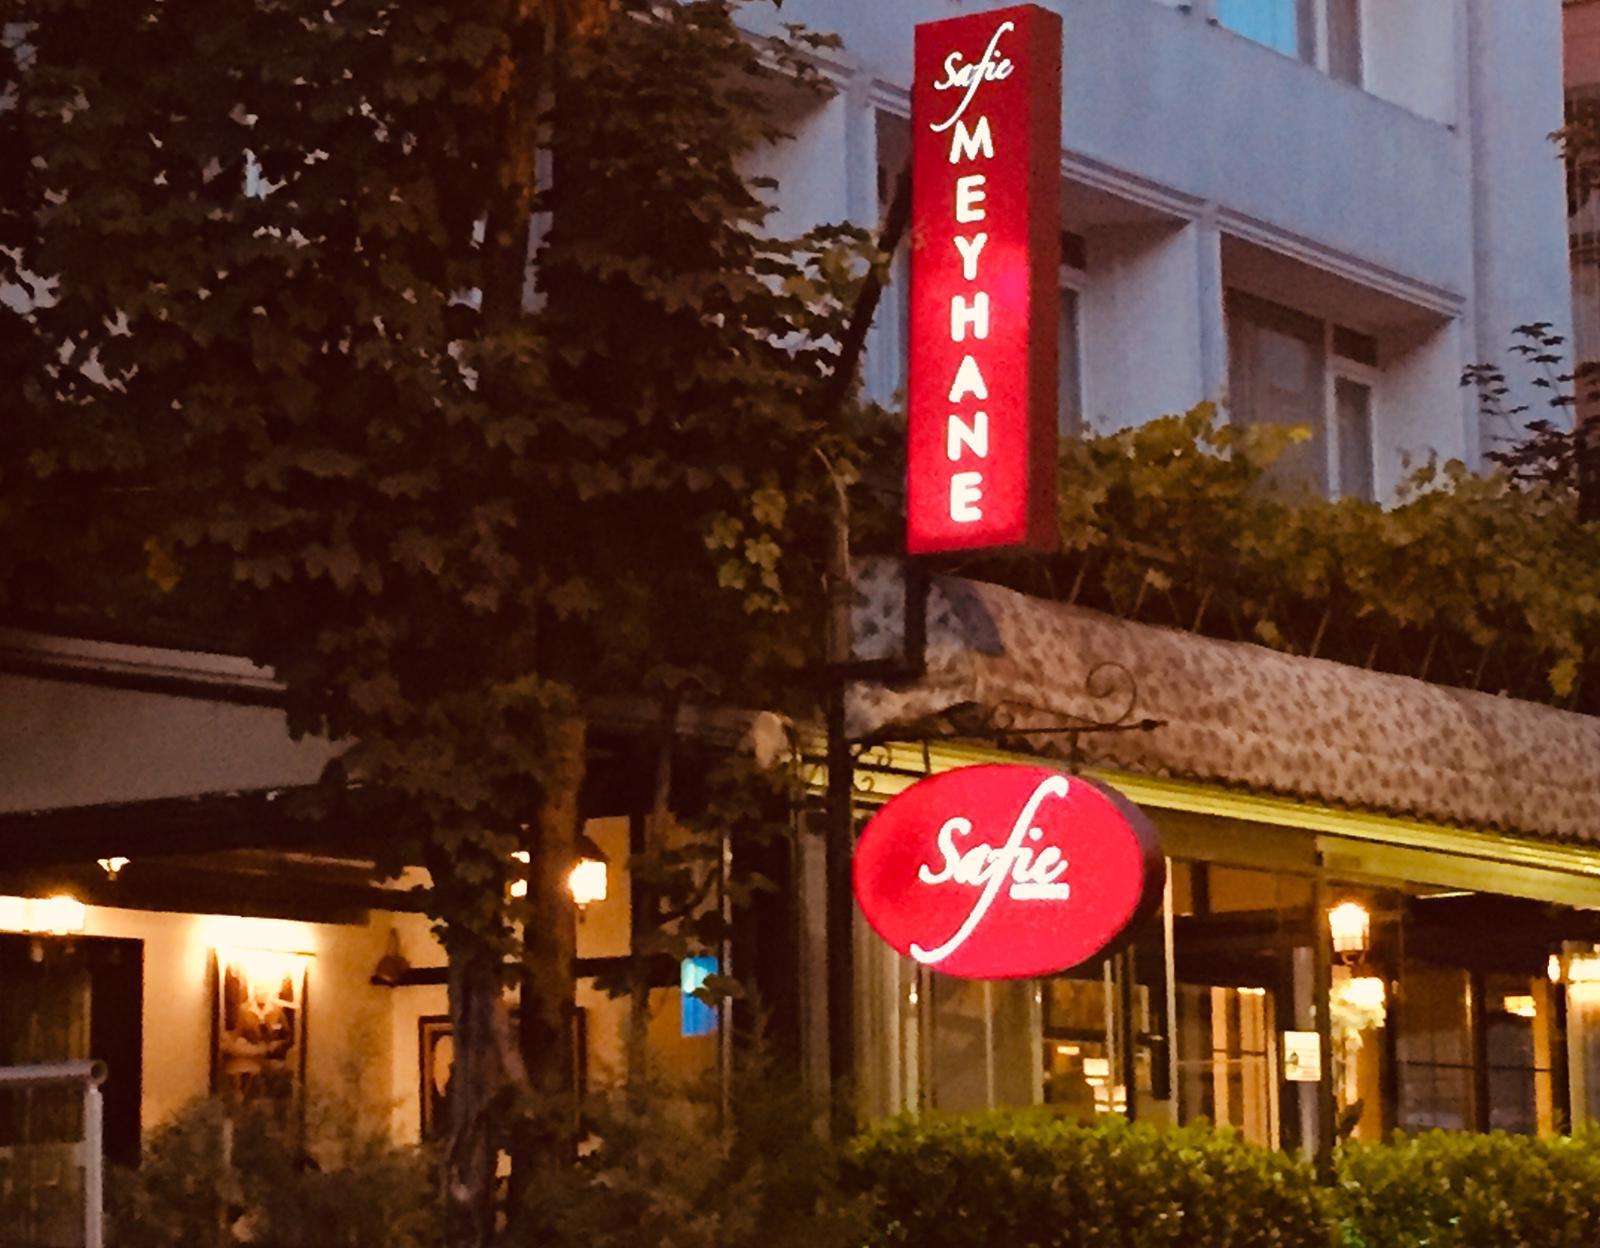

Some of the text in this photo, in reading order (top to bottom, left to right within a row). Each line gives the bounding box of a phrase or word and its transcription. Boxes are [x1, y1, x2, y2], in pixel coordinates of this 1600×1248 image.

[929, 21, 1014, 131] Safie
[947, 115, 994, 523] MEYHANE
[910, 775, 1069, 964] Safie
